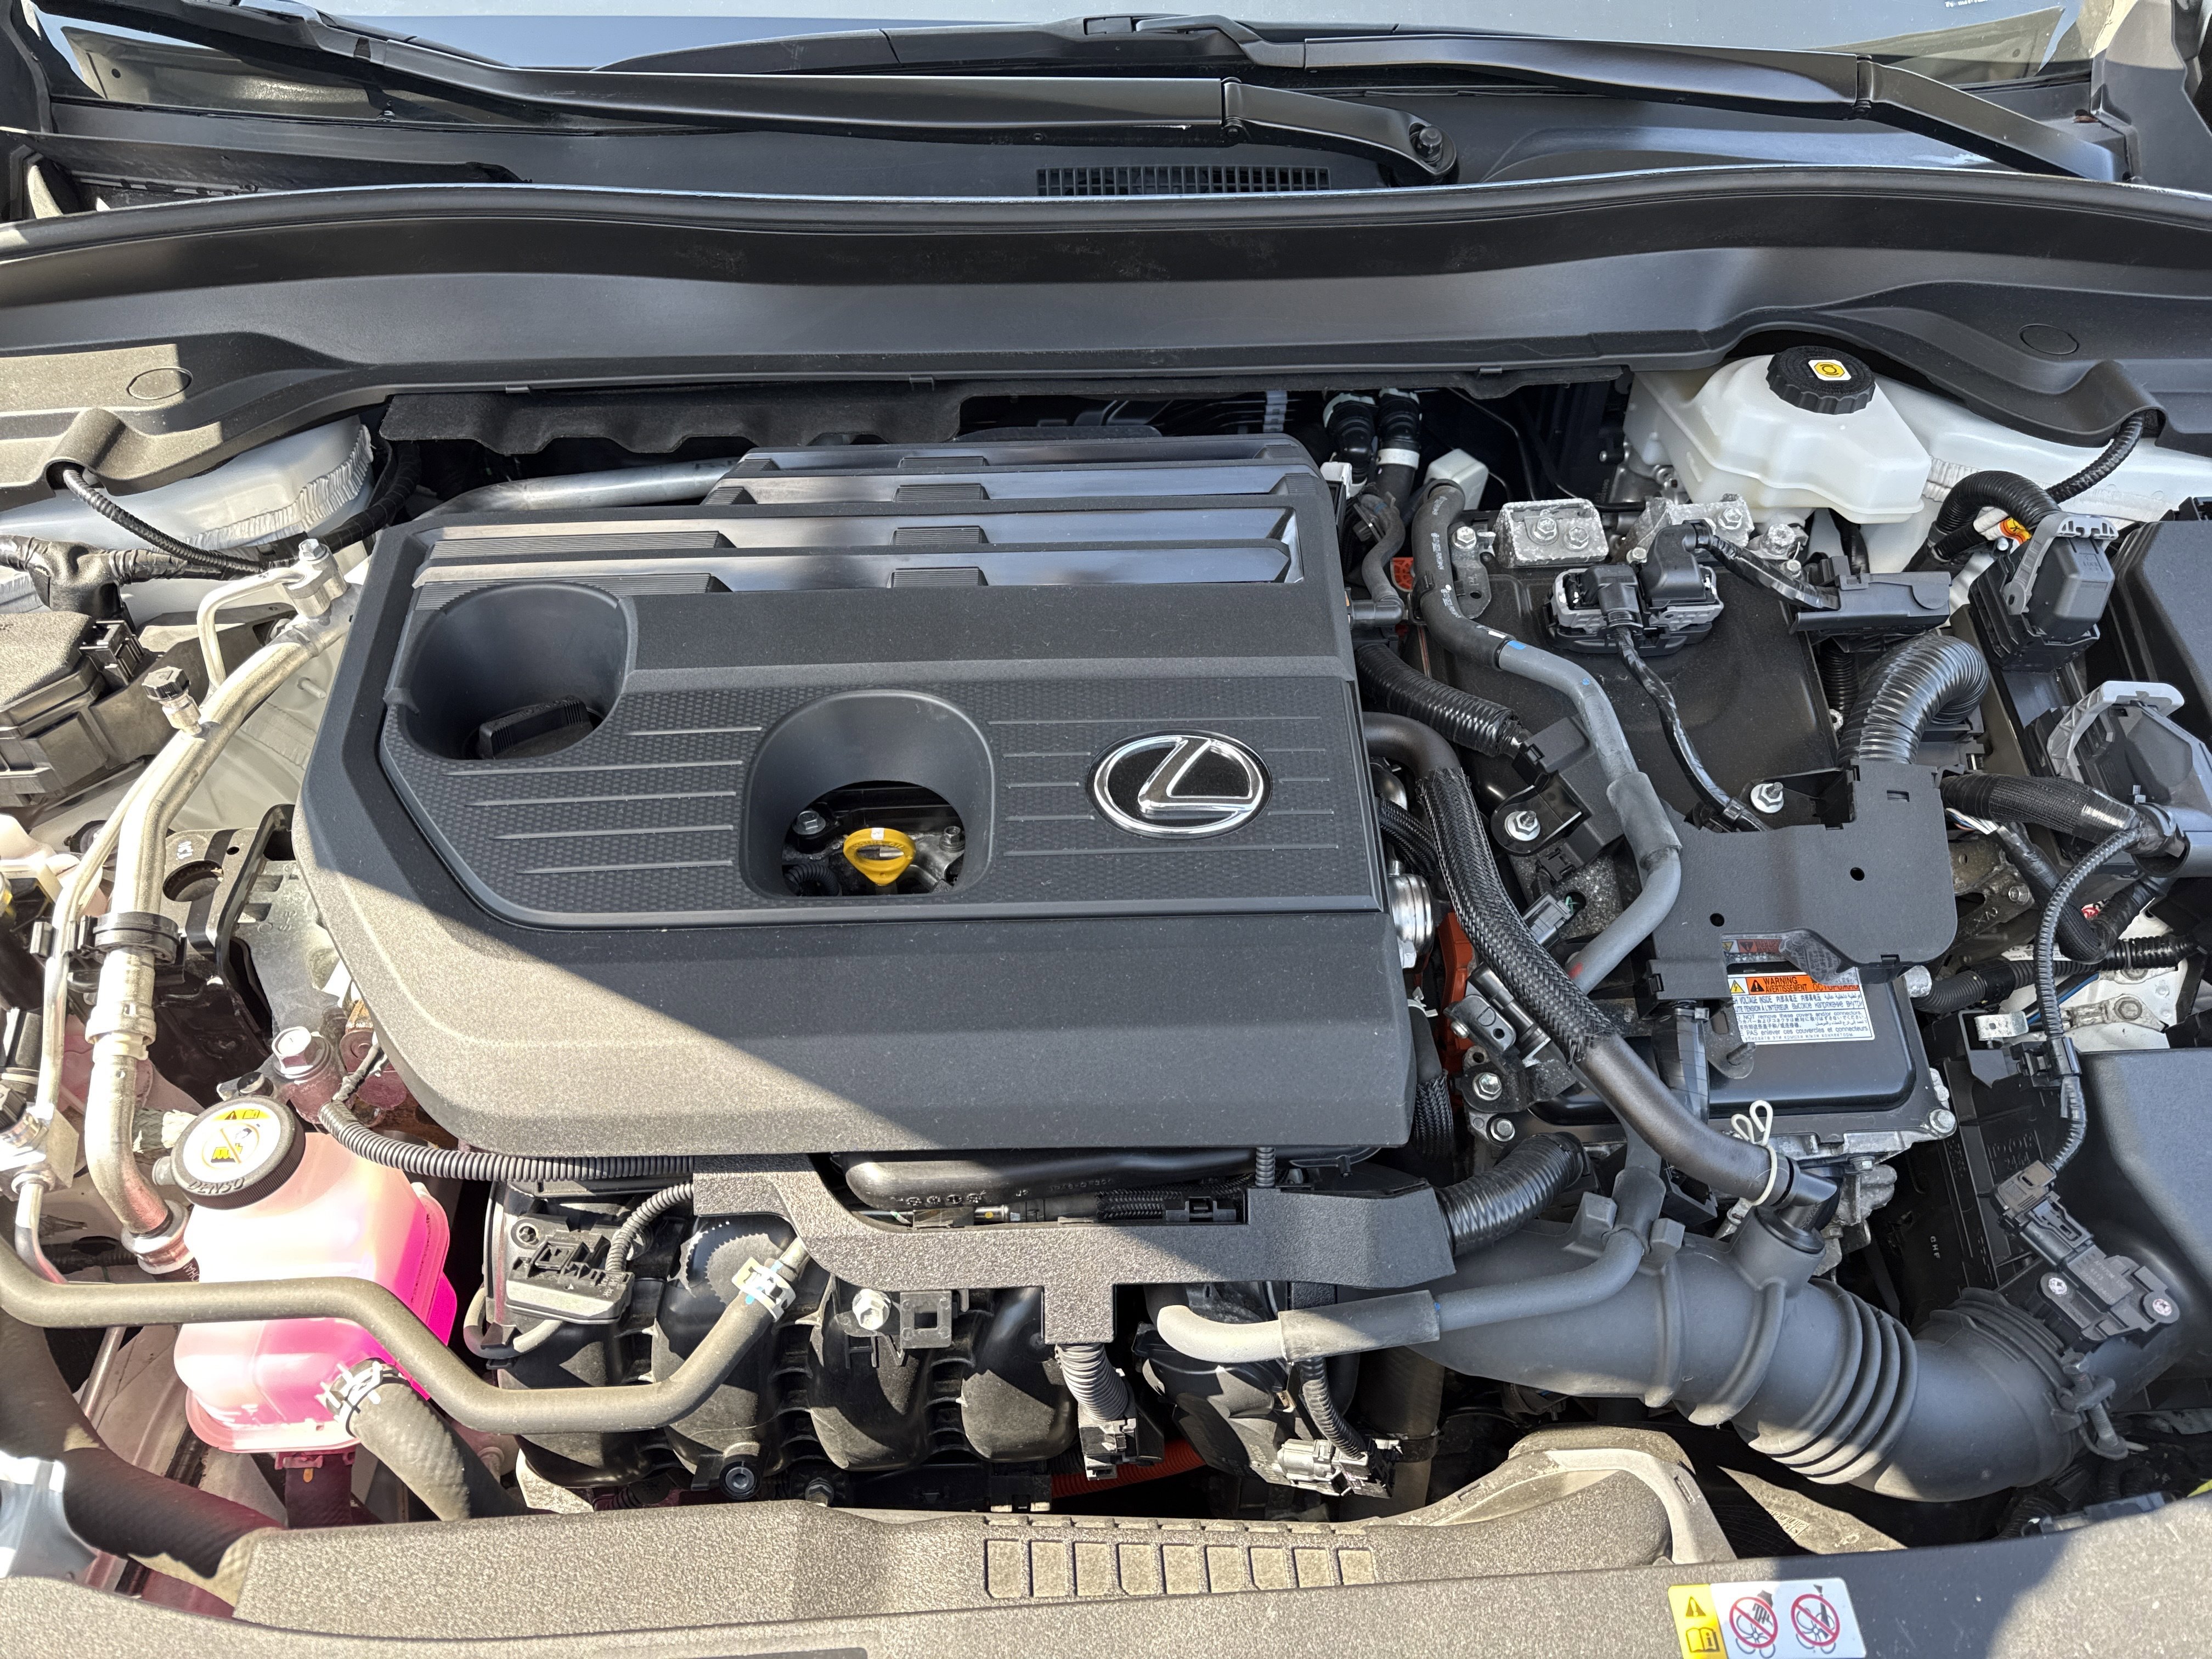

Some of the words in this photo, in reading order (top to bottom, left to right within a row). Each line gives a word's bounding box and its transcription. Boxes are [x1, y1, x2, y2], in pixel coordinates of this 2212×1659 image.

[1762, 977, 1798, 985] WARNING
[1765, 984, 1808, 993] AVERTISSEMENT
[1739, 996, 1758, 1005] VOLTAGE
[1759, 995, 1773, 1003] INSIDE
[188, 1177, 245, 1194] DENSO
